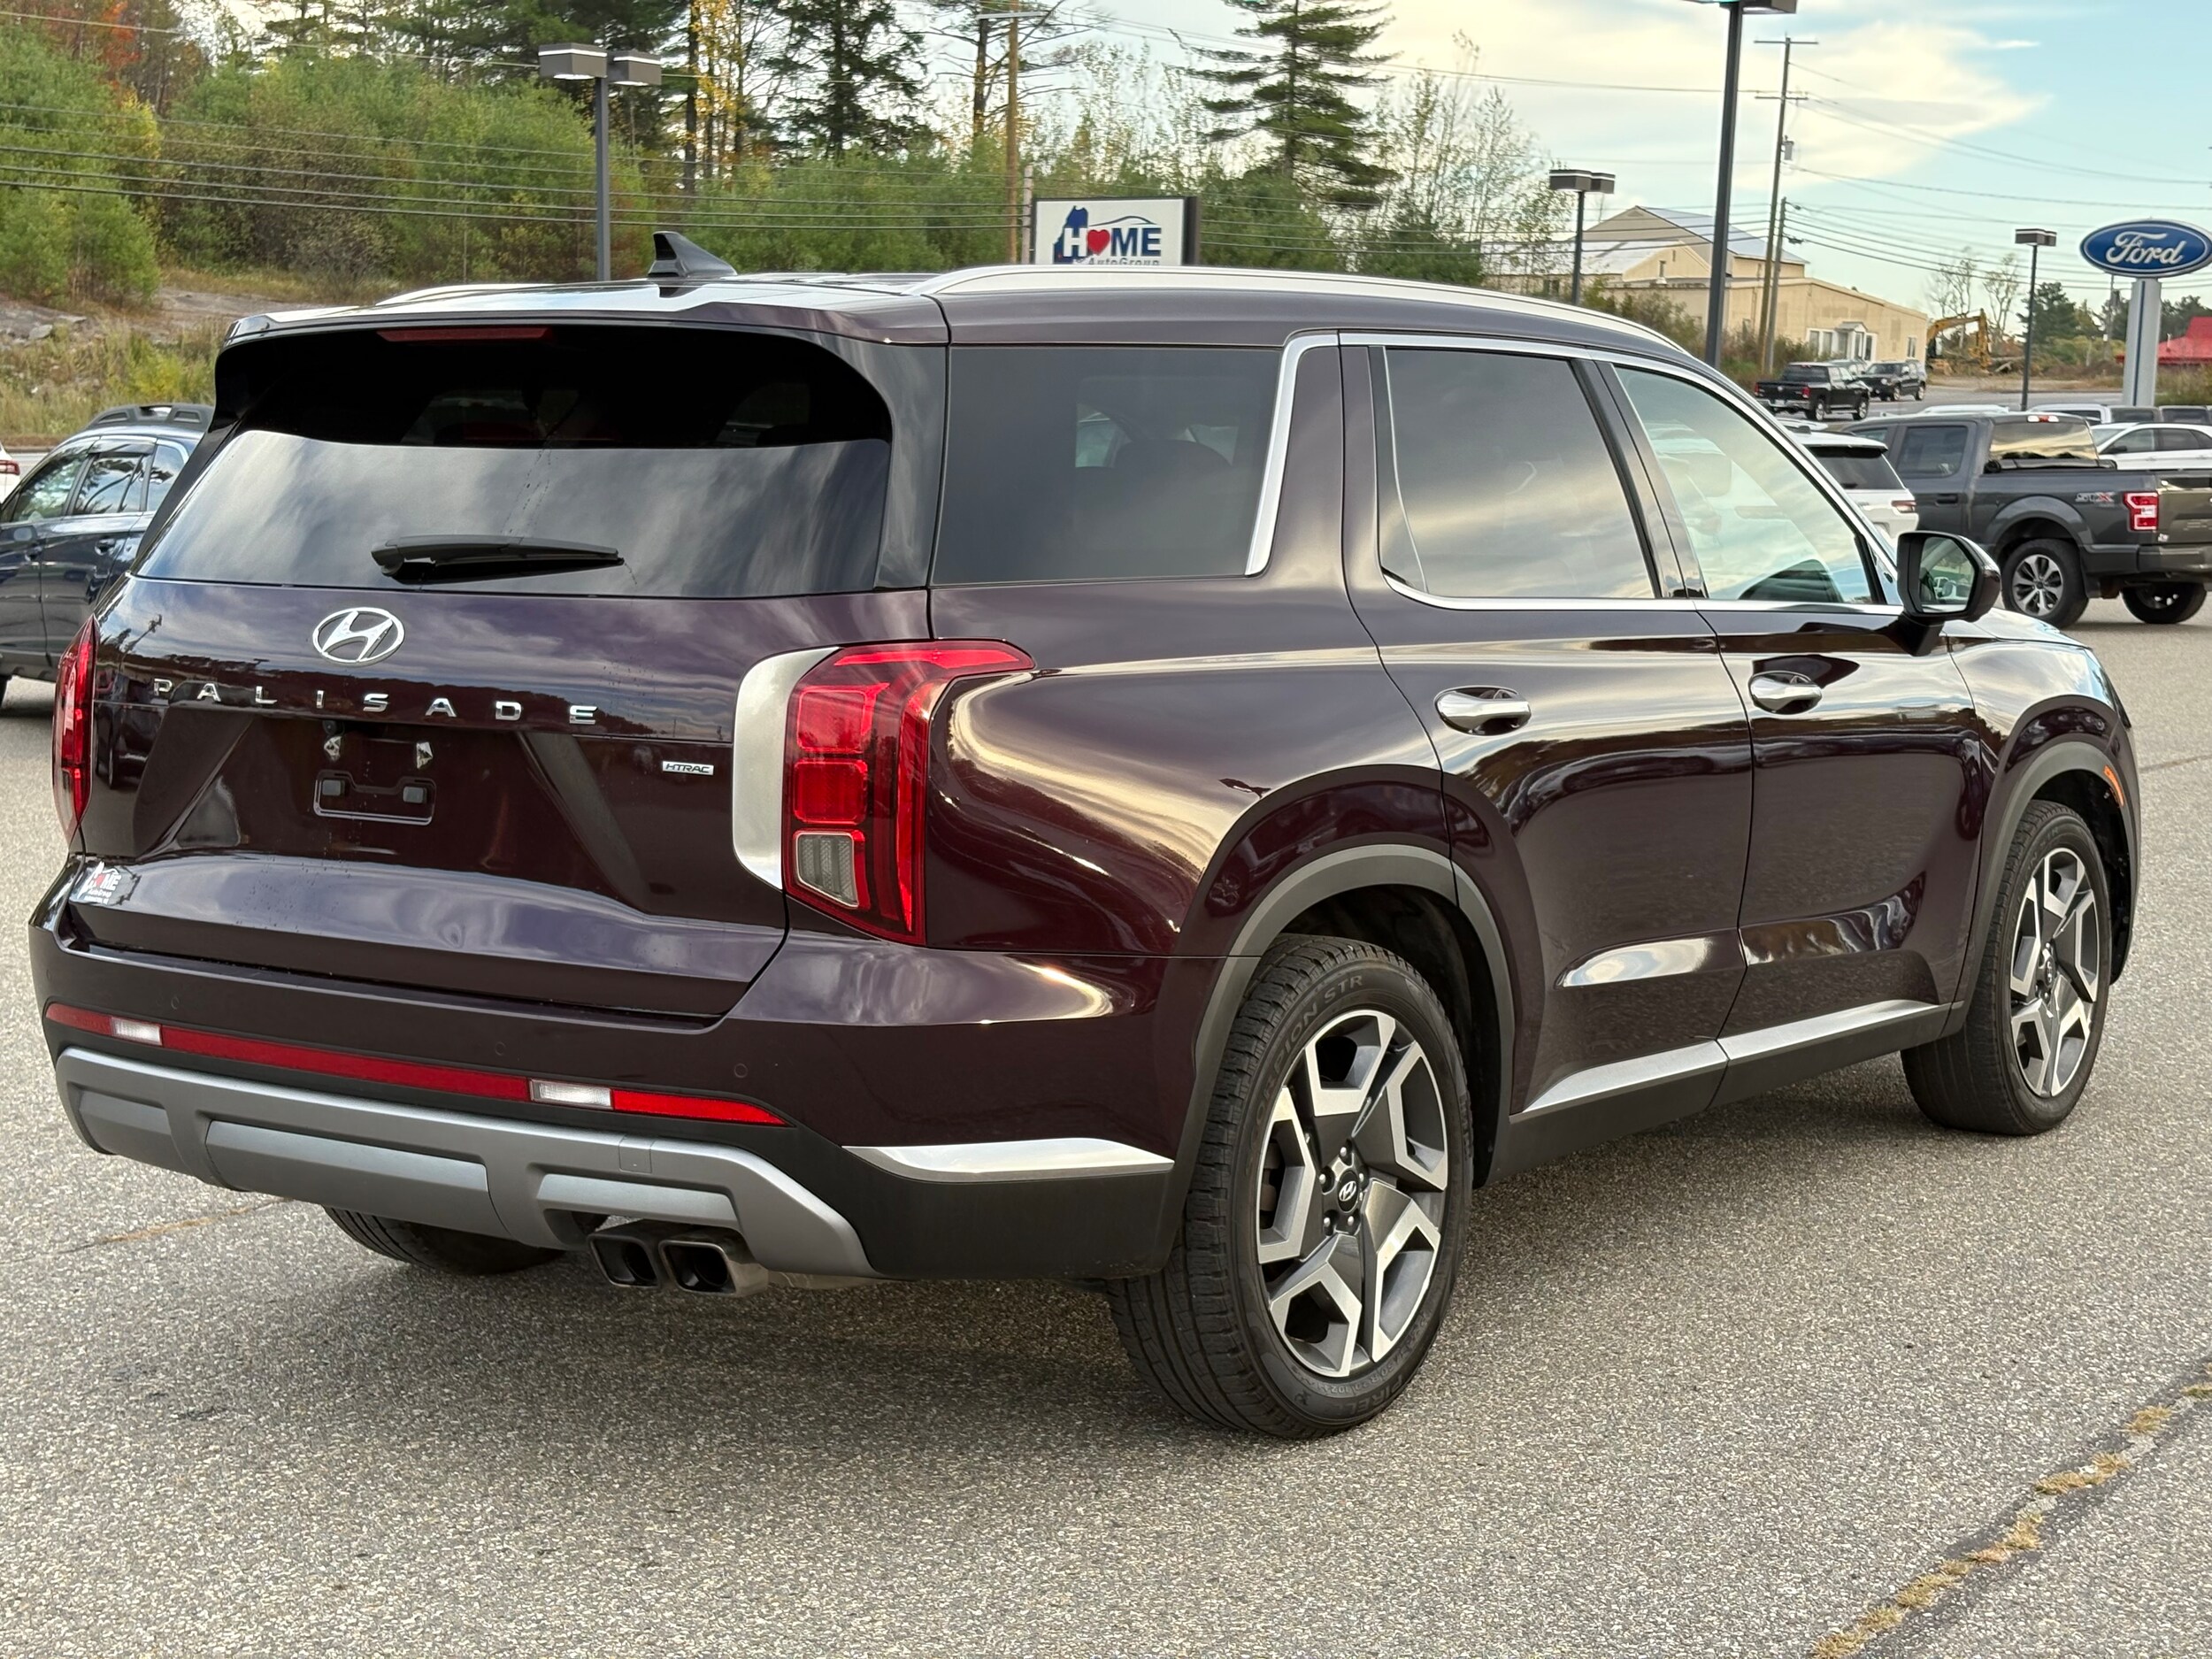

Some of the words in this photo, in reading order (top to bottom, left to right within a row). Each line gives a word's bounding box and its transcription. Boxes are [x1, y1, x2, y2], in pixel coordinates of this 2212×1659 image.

[2106, 231, 2187, 264] Ford
[154, 678, 598, 725] PALISADE
[665, 763, 710, 773] HTRAC
[1325, 974, 1363, 1004] STR
[1331, 1374, 1402, 1414] PIRELL
